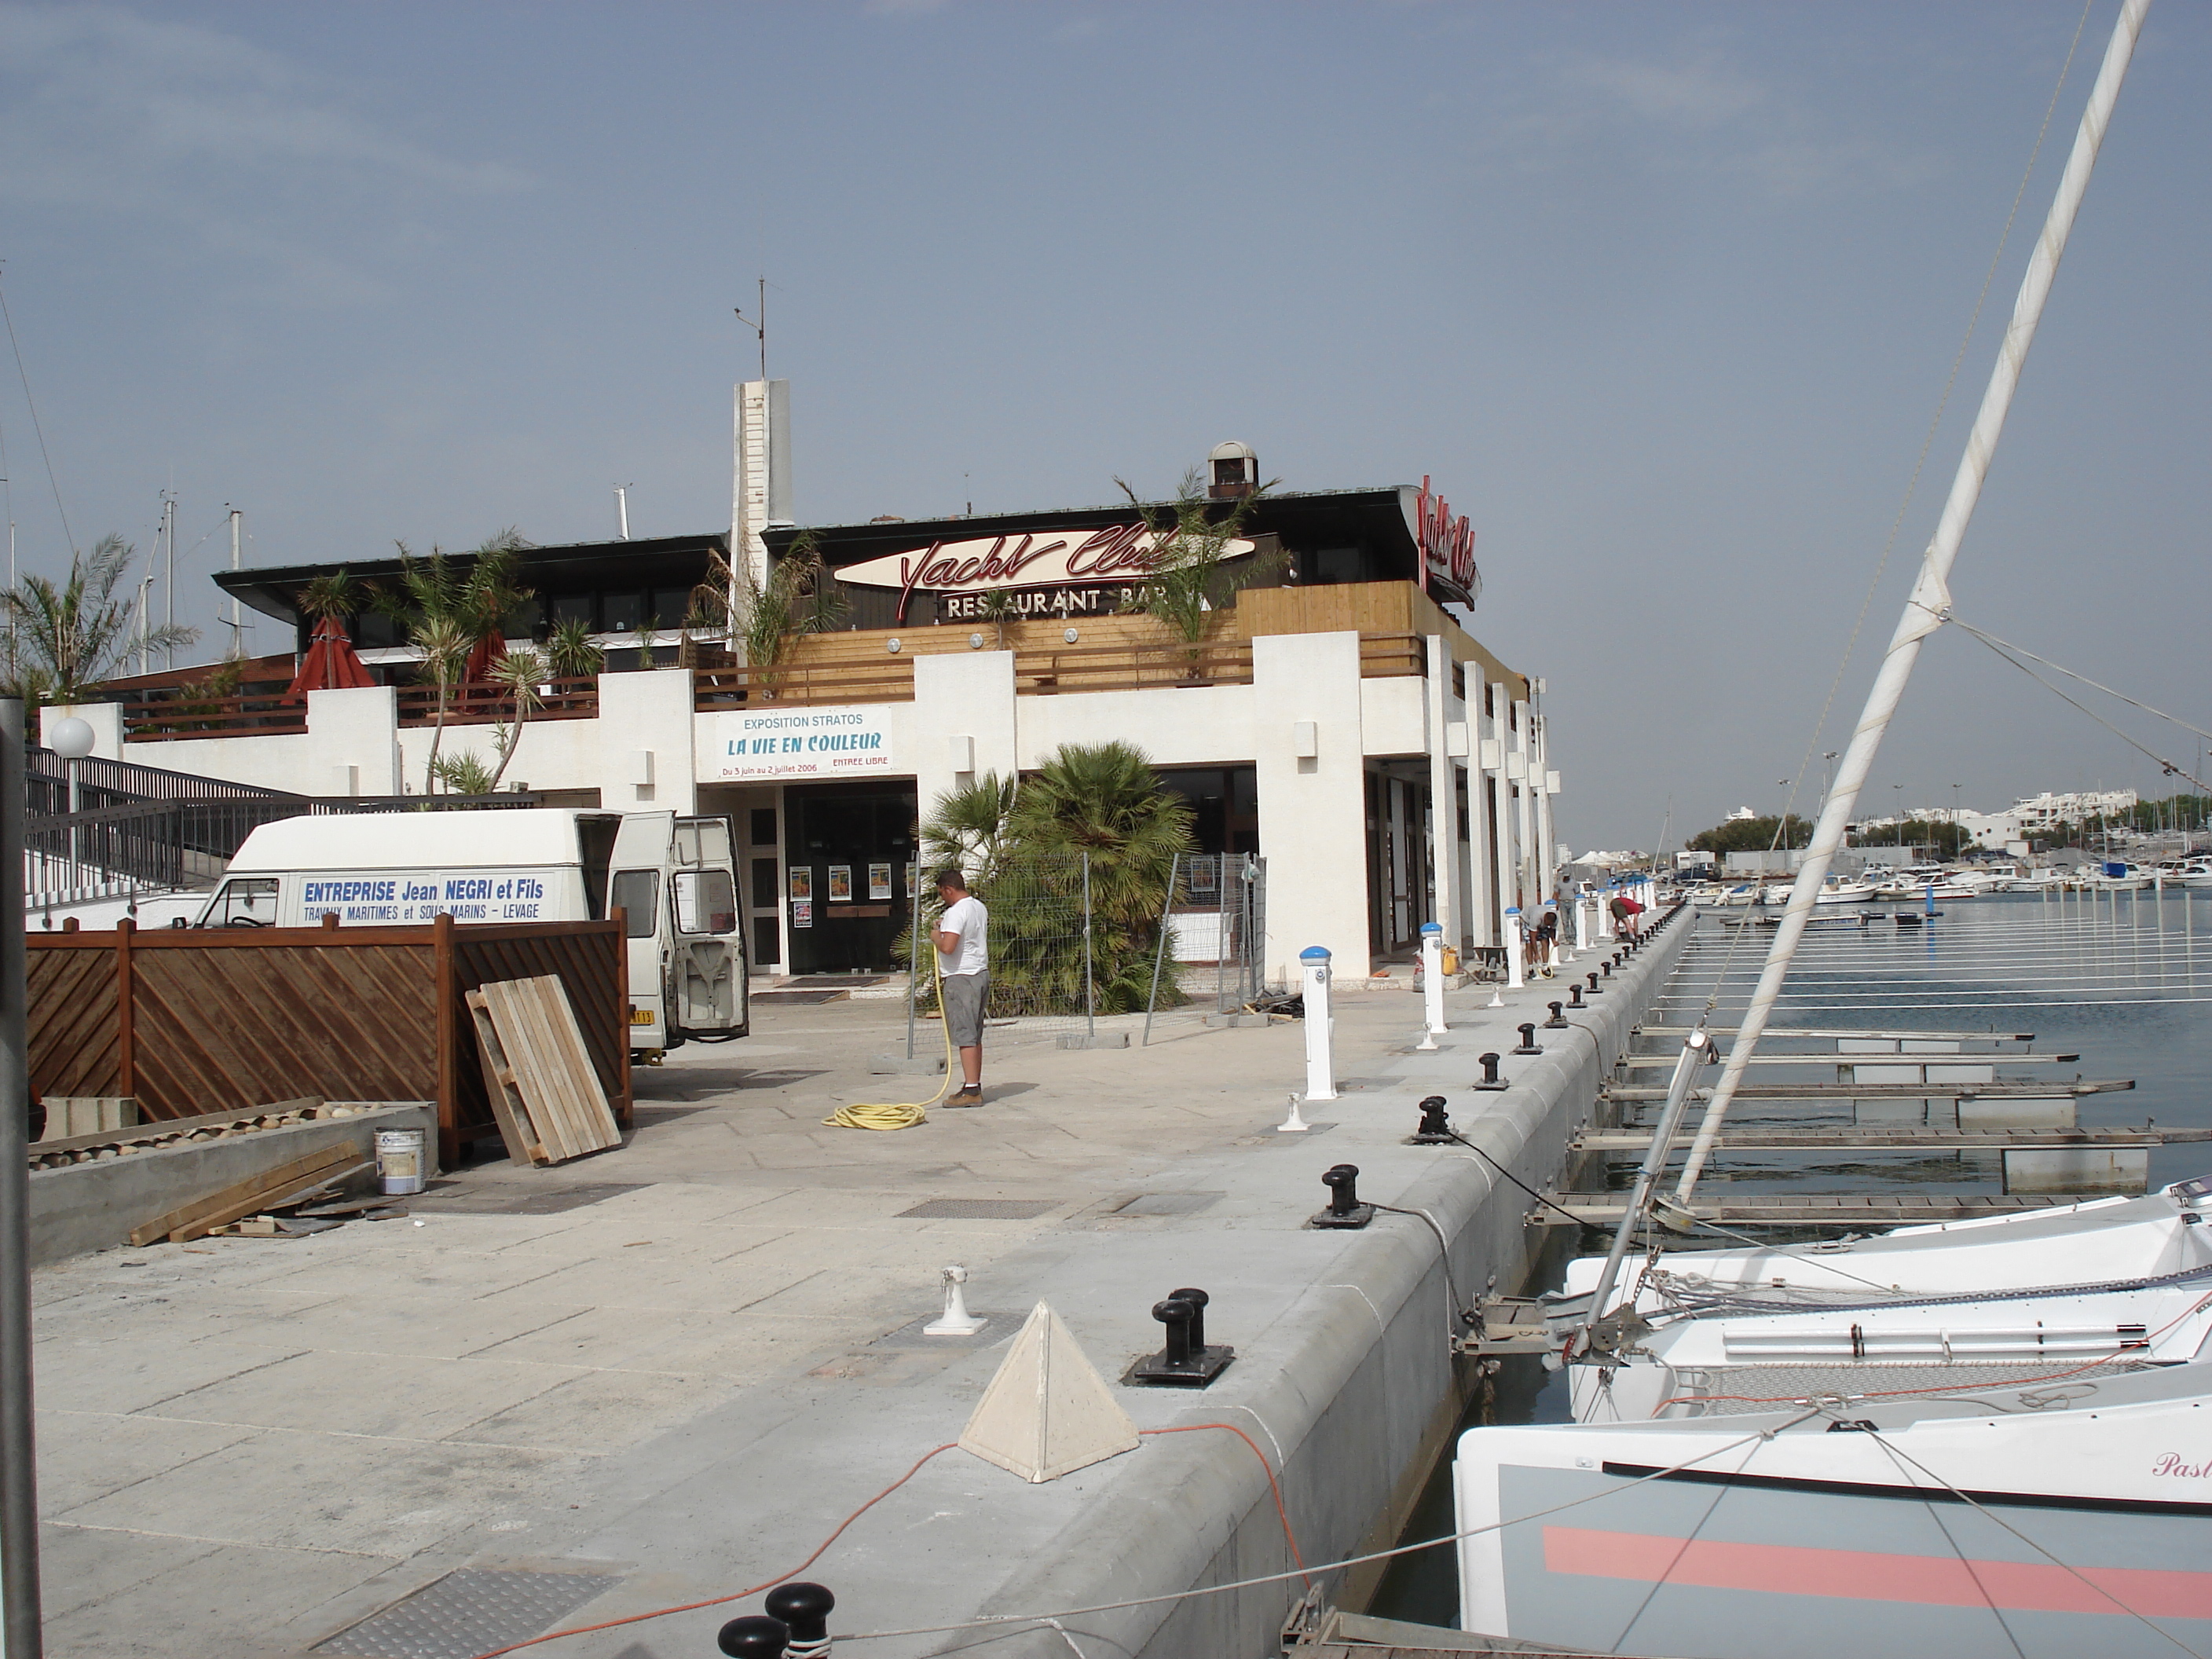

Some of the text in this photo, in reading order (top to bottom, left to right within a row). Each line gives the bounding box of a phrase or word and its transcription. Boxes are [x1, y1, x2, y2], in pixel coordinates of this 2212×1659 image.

[896, 540, 1068, 621] Yacht
[948, 590, 1100, 617] RESAURANT
[744, 713, 863, 730] EXPOSITION STRATOS
[728, 731, 882, 756] LA VIE EN COULEUR
[741, 767, 755, 777] juin
[773, 764, 796, 775] juillet
[797, 764, 818, 773] 2006
[833, 756, 888, 767] ENTREE LIBRE
[305, 878, 544, 903] ENTREPRISE Jean NEGRI et Fils
[347, 906, 398, 921] MARITIMES
[404, 906, 413, 919] et
[419, 905, 444, 919] SOUS
[449, 904, 486, 919] MARINS
[504, 904, 539, 918] LEVAGE
